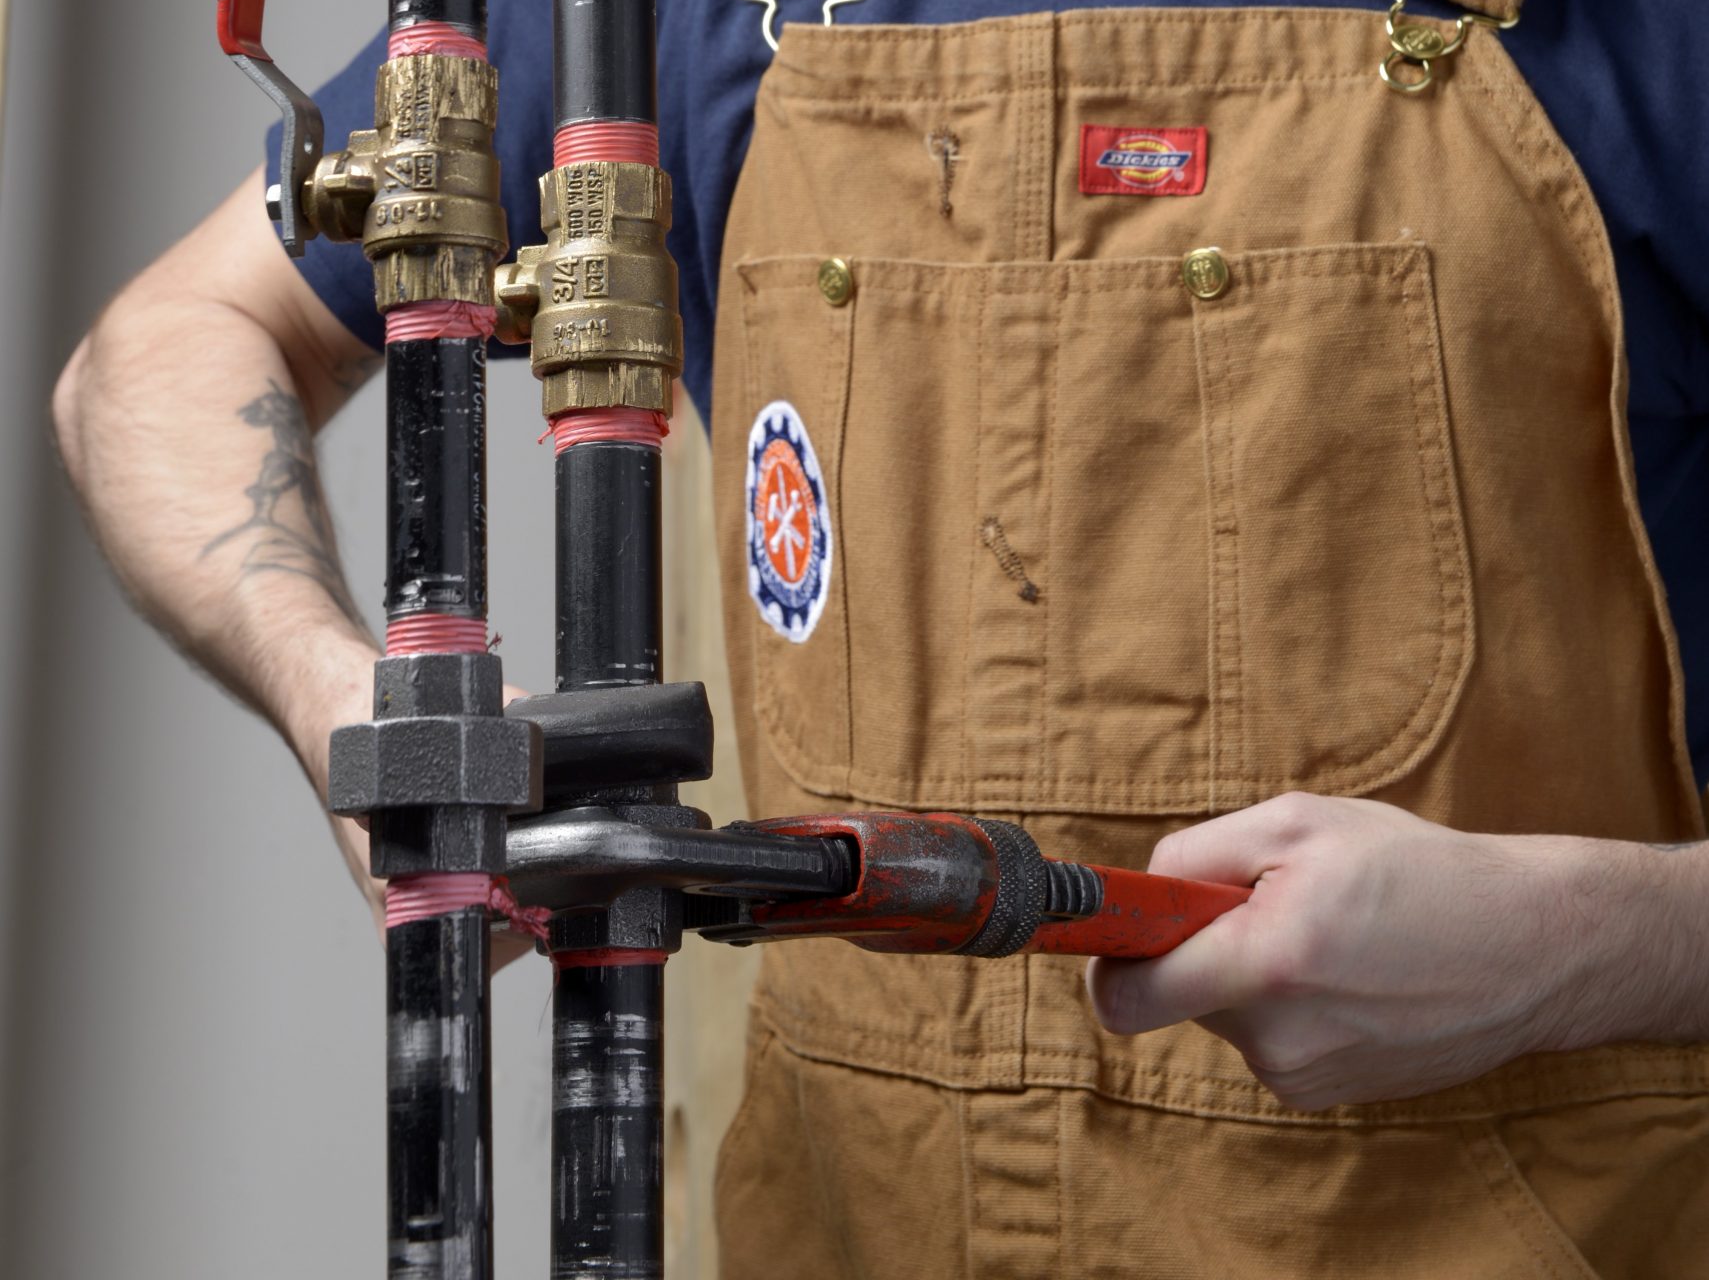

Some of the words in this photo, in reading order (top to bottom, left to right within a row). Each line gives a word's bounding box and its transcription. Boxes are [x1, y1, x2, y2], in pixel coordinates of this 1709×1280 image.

[1108, 153, 1180, 167] Dickies
[568, 169, 583, 206] WOG
[588, 168, 603, 207] WSP
[568, 210, 583, 239] 600
[588, 209, 603, 234] 150
[552, 255, 580, 304] 3/4
